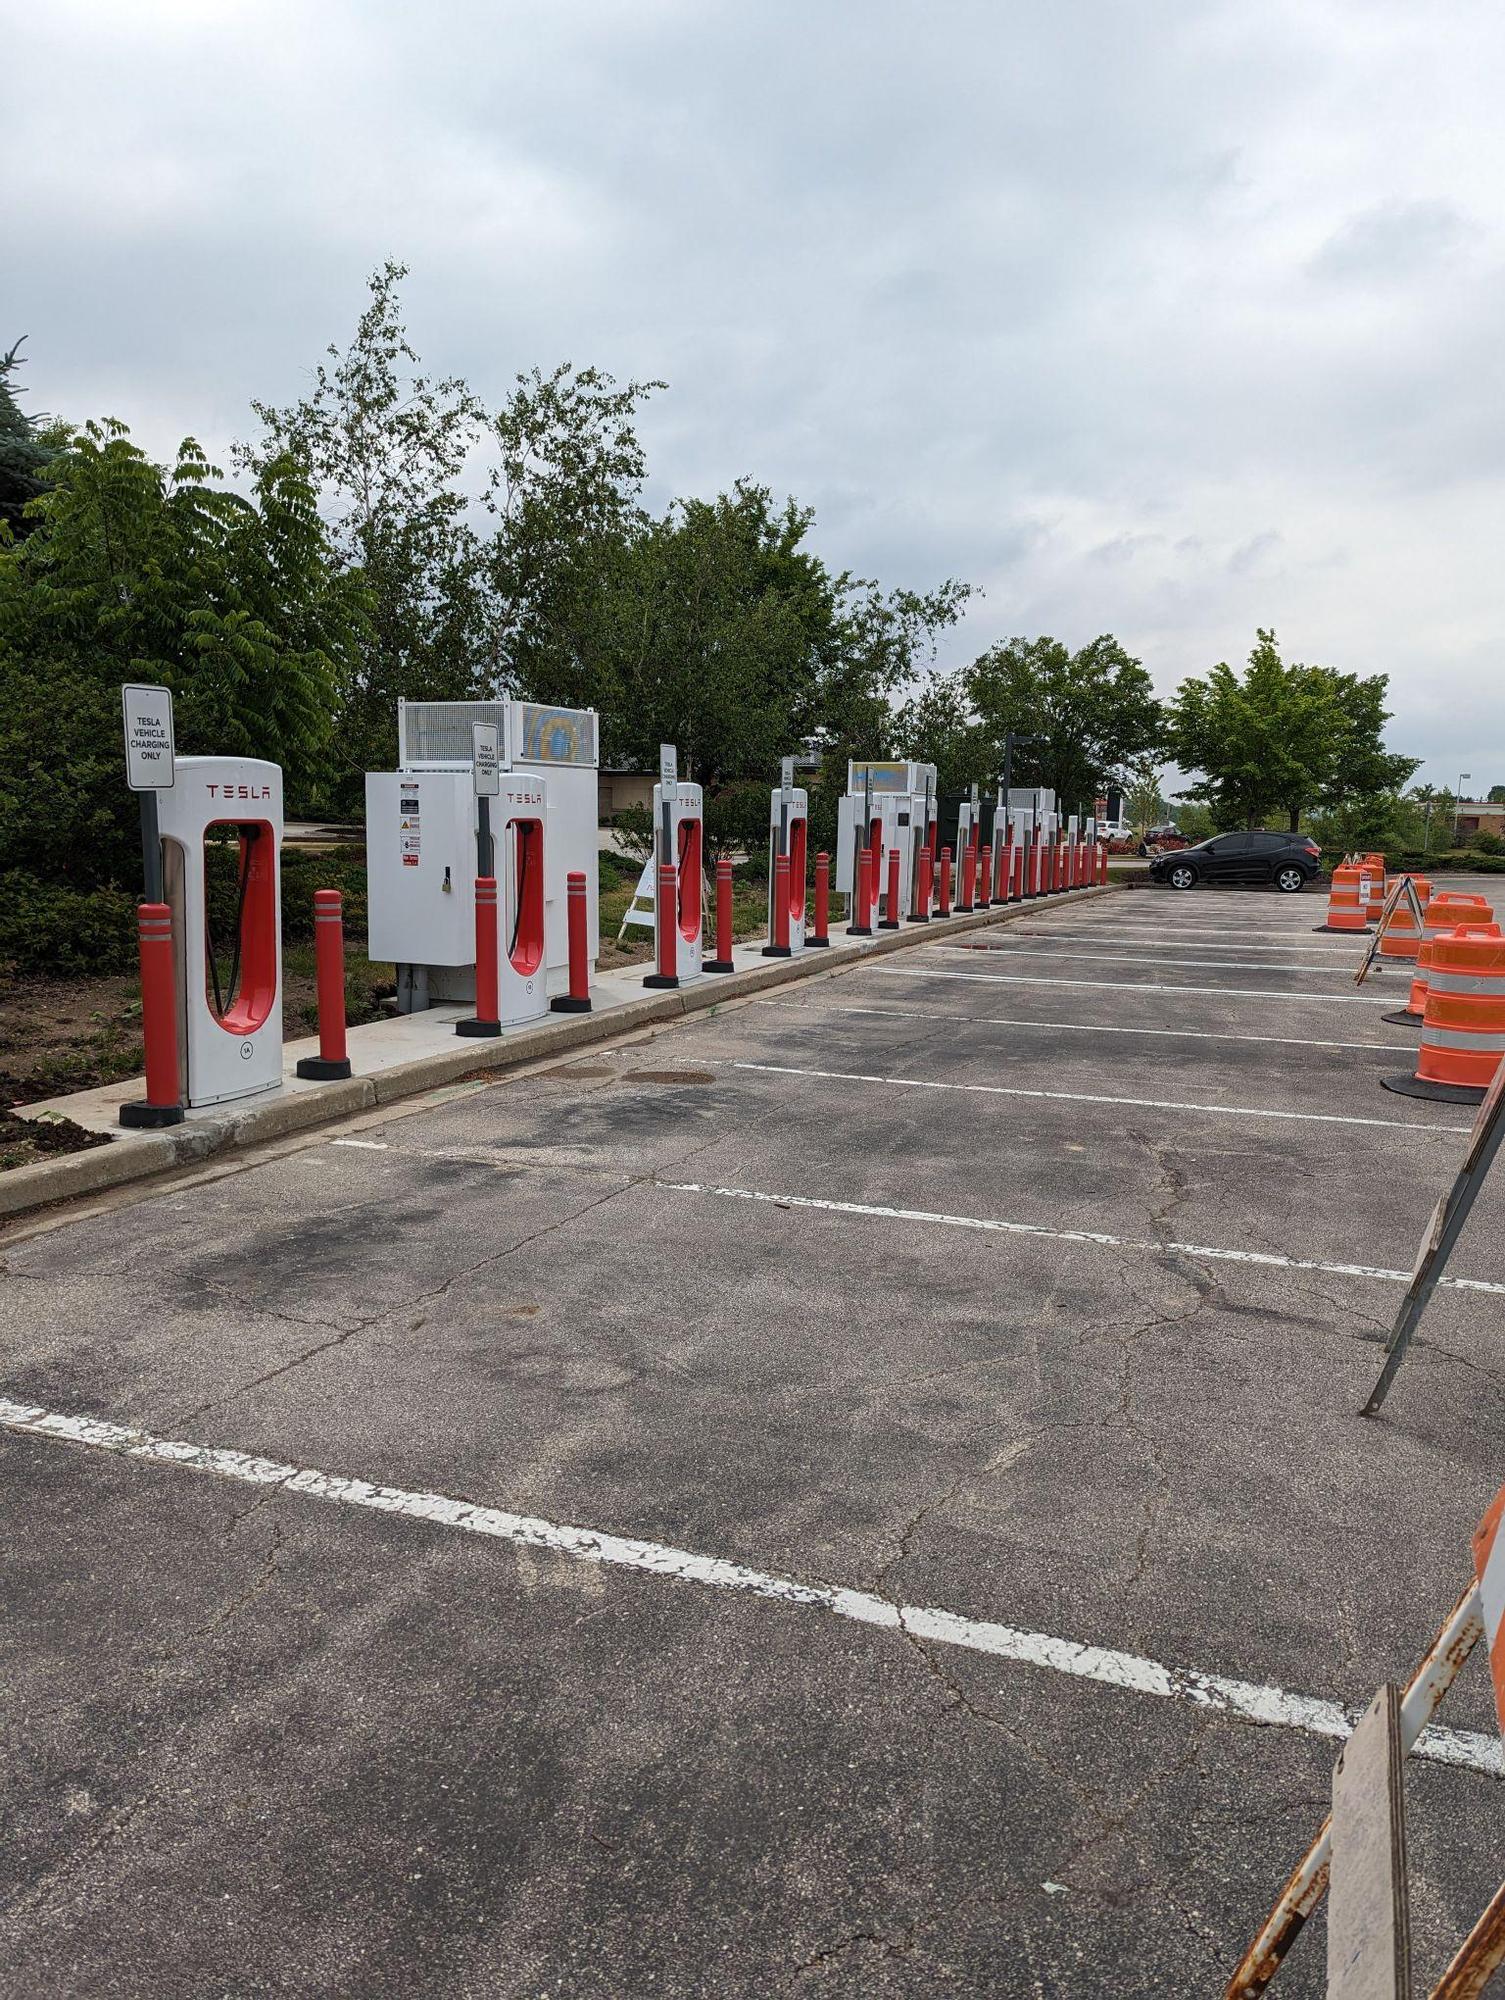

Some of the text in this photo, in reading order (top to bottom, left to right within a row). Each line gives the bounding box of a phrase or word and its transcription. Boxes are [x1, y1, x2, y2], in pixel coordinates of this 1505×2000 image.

[137, 717, 161, 727] TESLA
[134, 729, 166, 738] VEHICLE
[131, 740, 170, 749] CHARGING
[141, 751, 162, 760] ONLY
[206, 784, 271, 799] TESLA
[507, 793, 542, 804] TESLA
